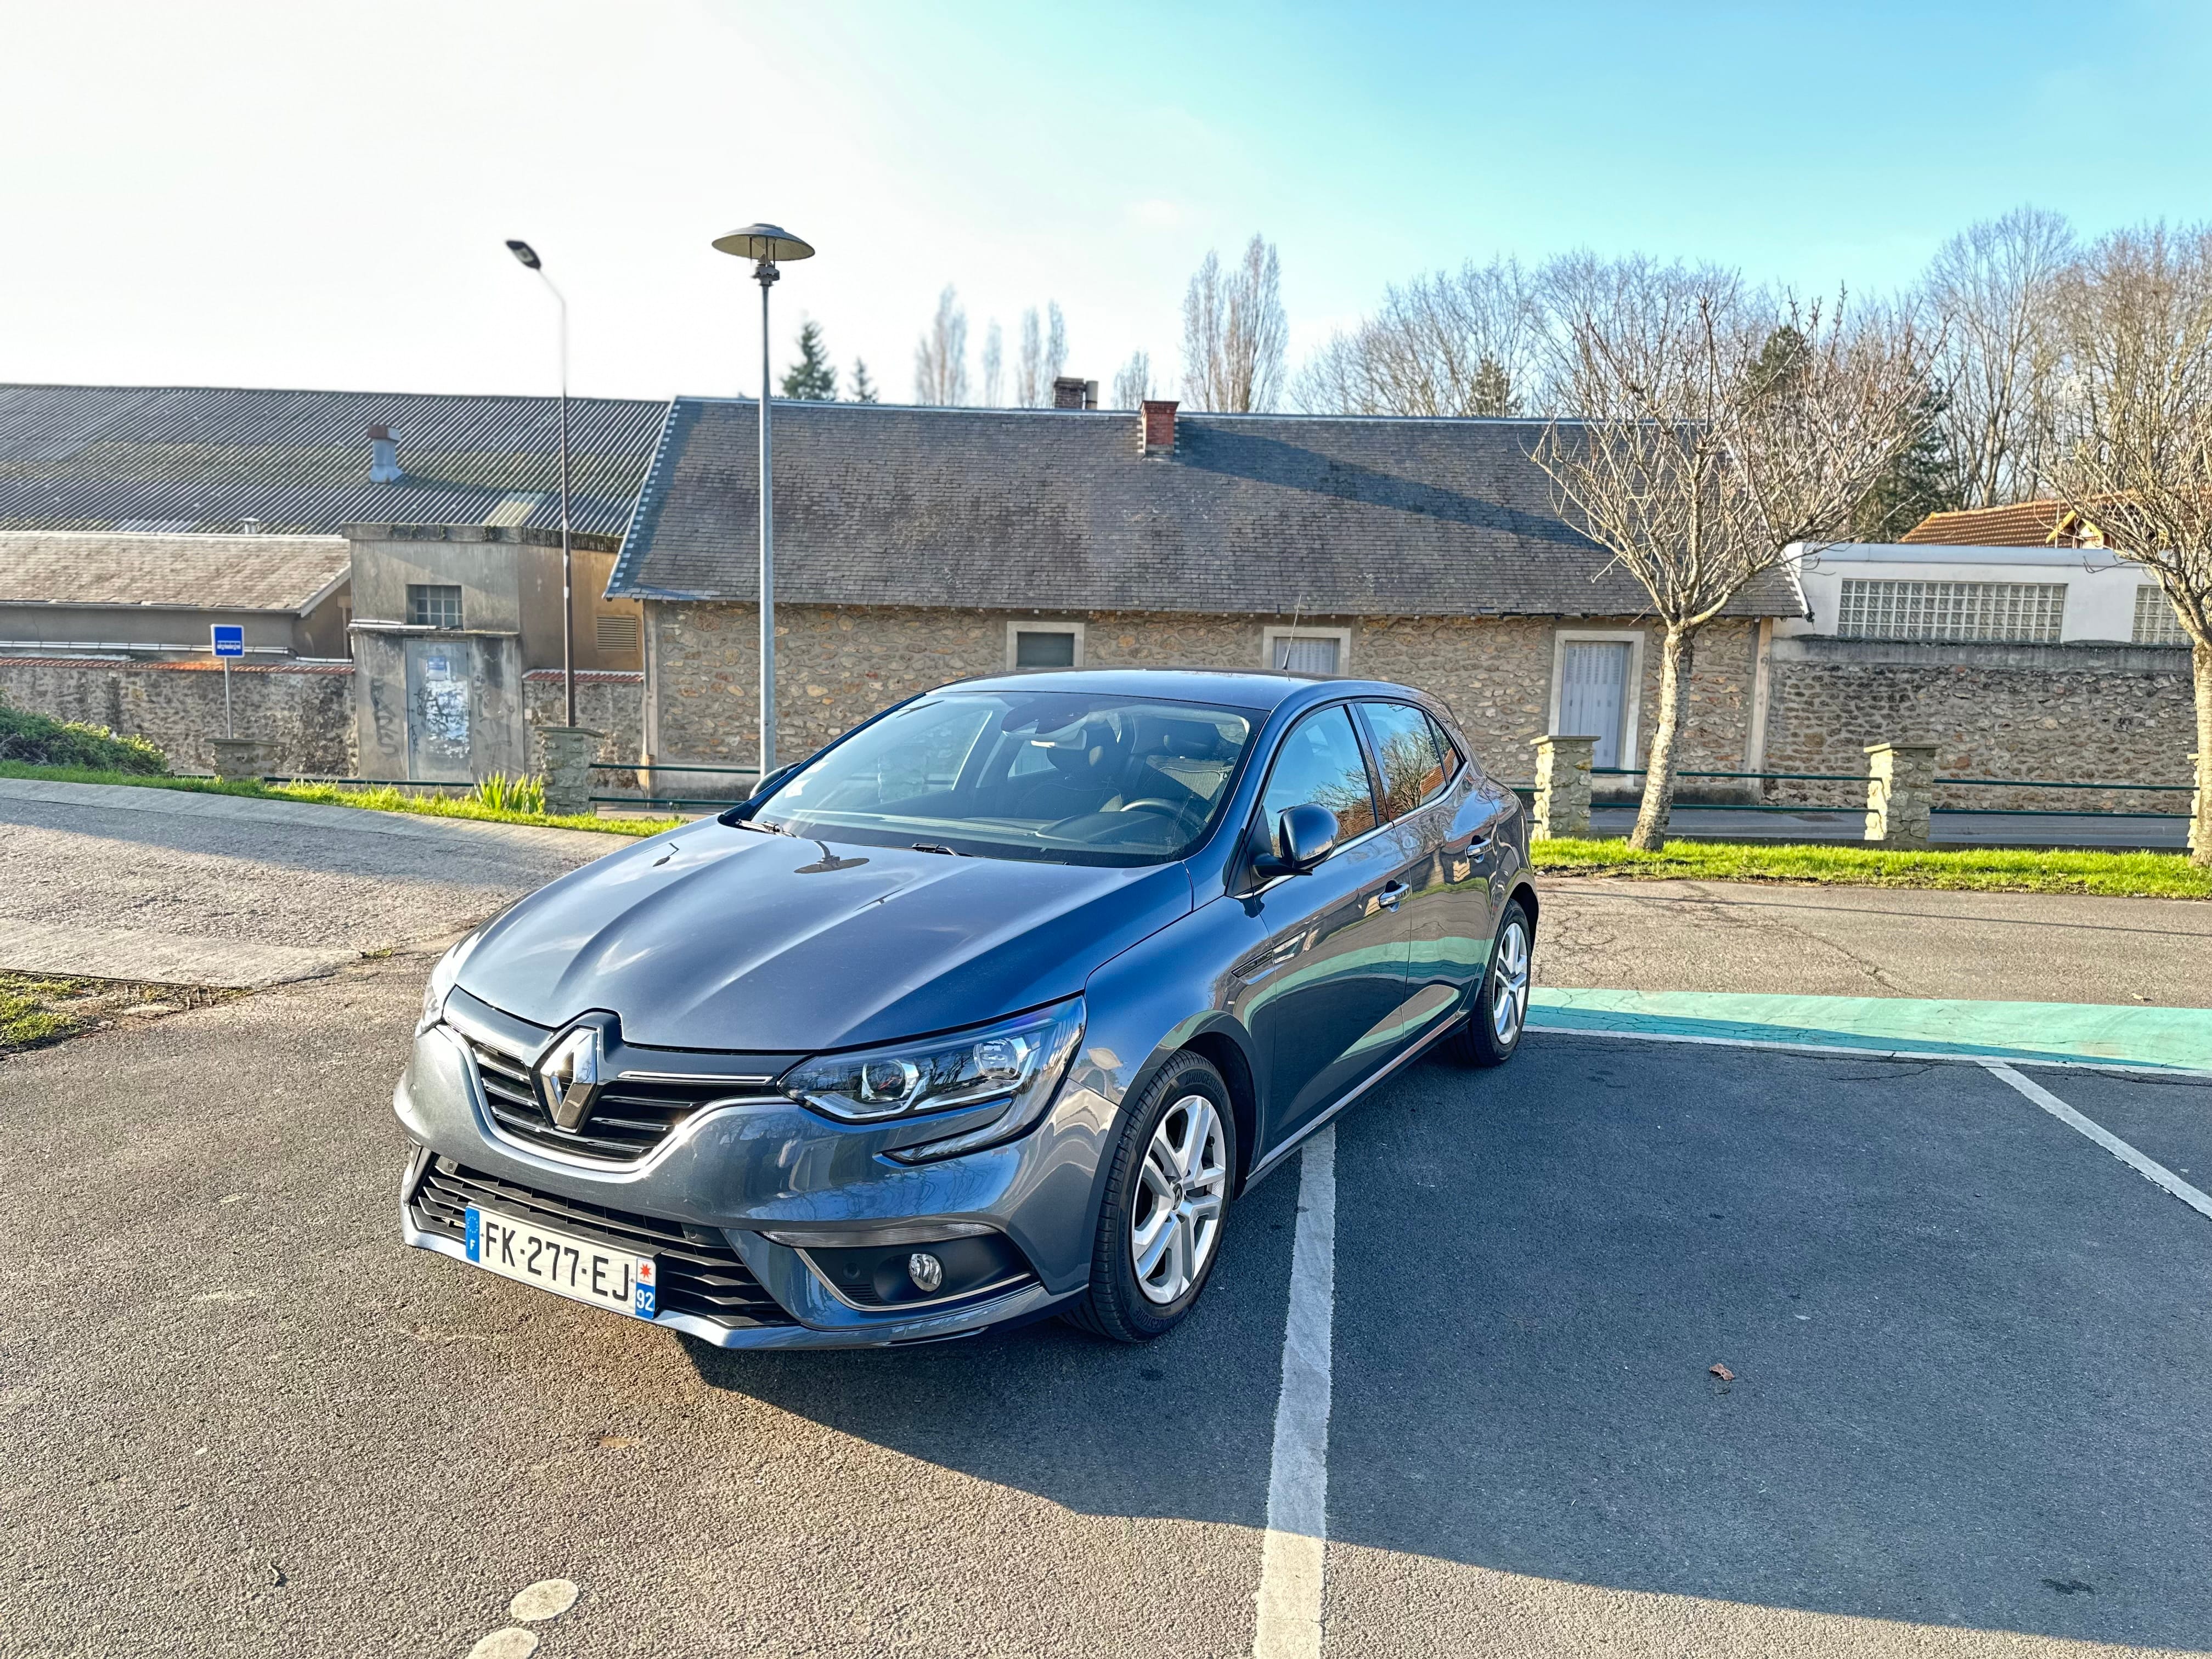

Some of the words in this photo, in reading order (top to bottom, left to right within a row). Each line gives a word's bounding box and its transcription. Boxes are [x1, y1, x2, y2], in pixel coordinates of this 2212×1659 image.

[1185, 1071, 1225, 1101] BRIDGESTONE
[470, 1239, 476, 1250] F
[486, 1221, 629, 1302] FK-277-EJ
[636, 1289, 654, 1312] 92
